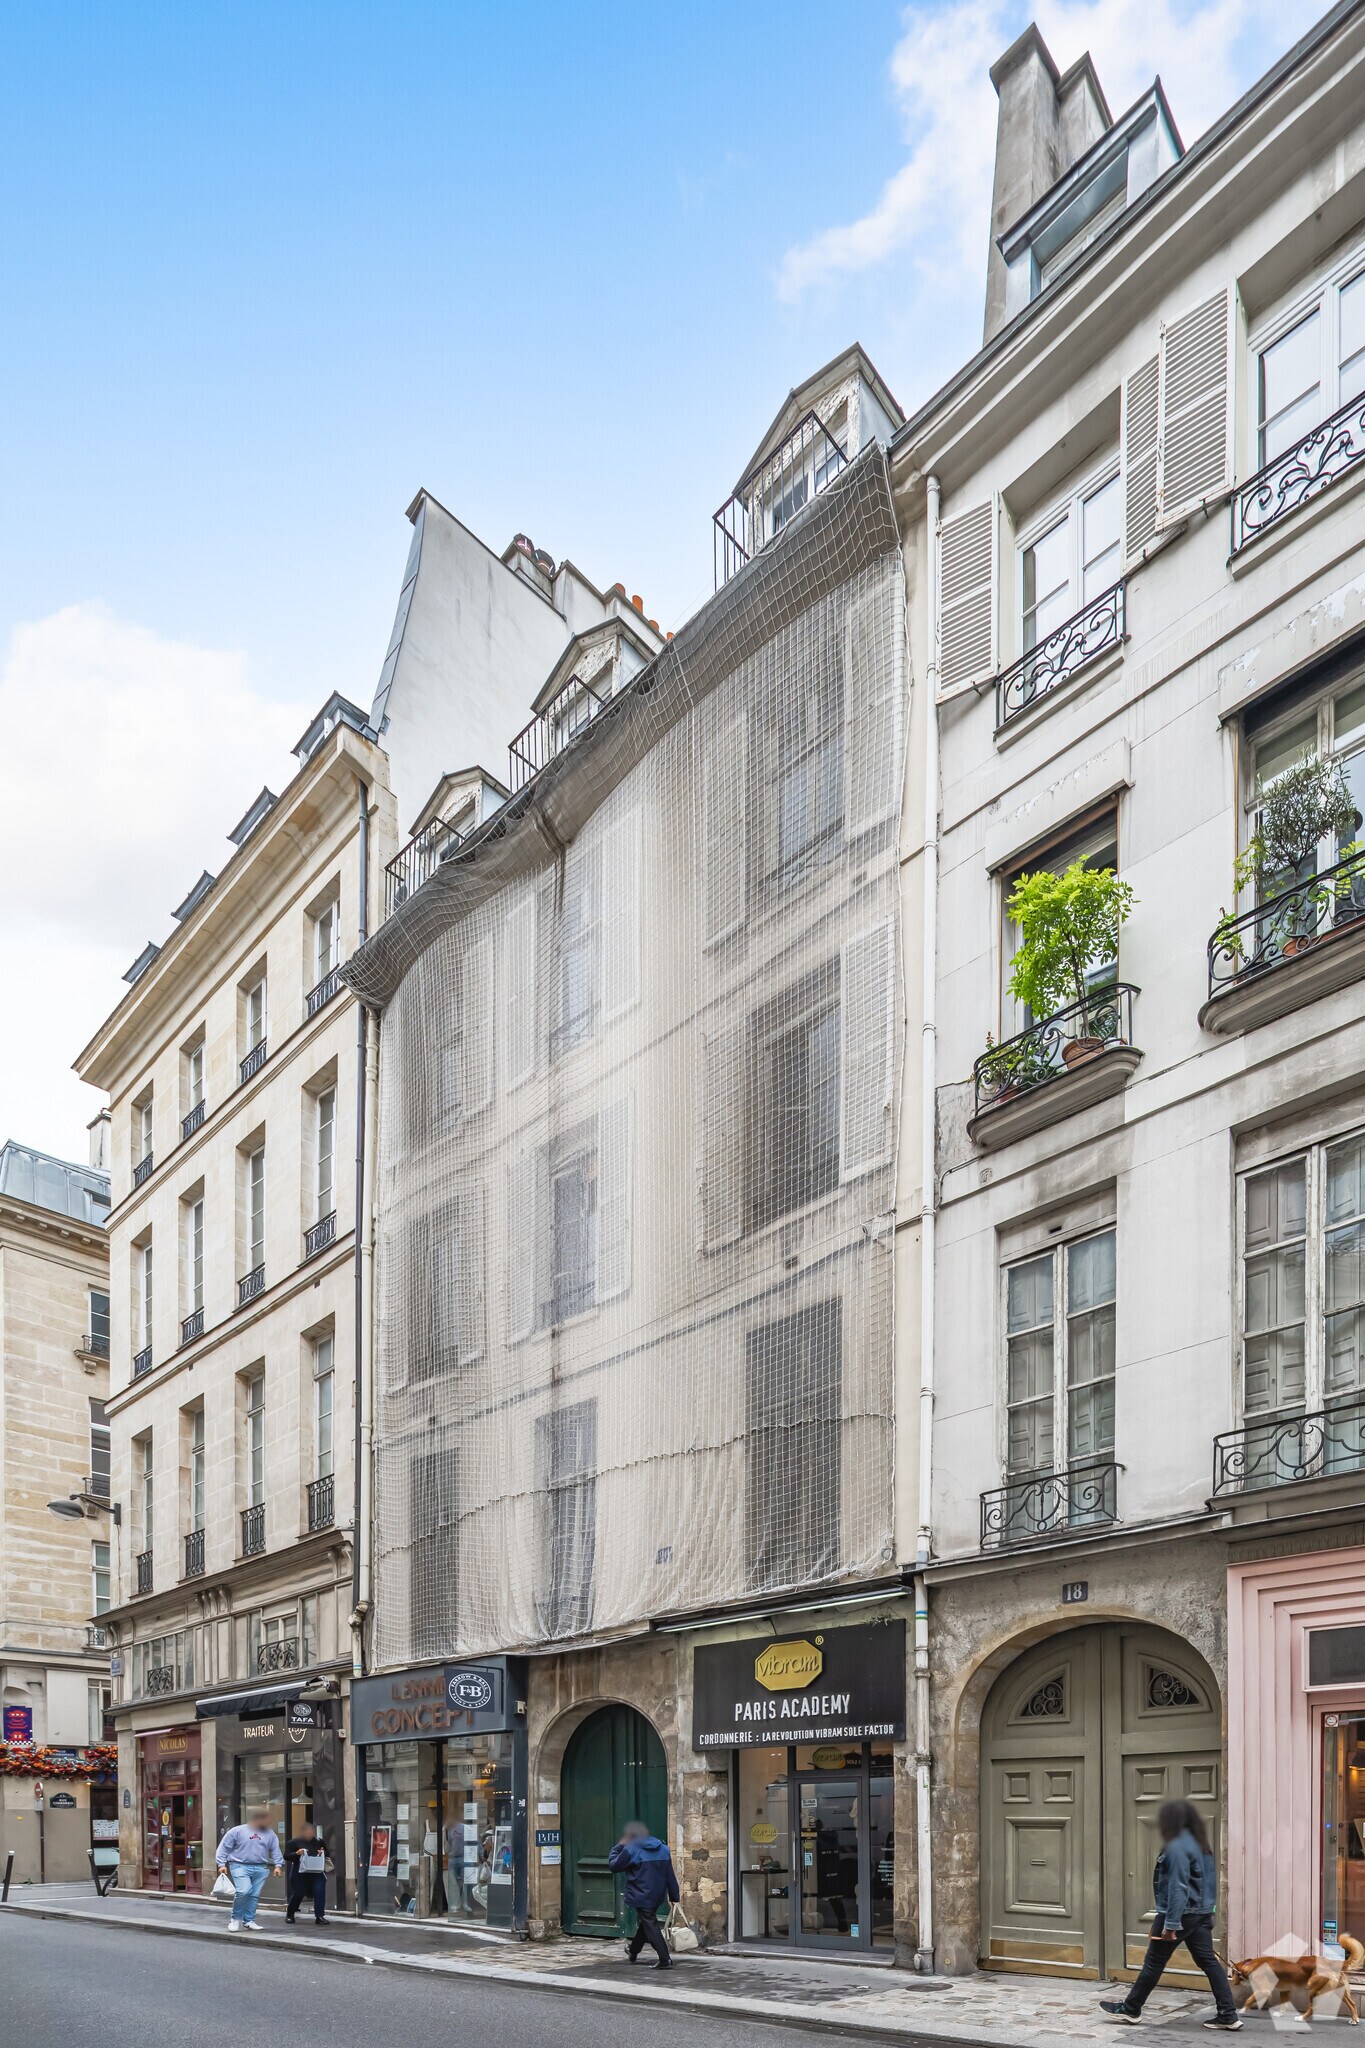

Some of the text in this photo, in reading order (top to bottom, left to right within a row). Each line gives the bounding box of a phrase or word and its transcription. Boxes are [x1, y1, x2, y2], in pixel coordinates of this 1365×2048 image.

[1066, 1584, 1083, 1601] 18
[759, 1654, 820, 1677] vibram
[458, 1684, 483, 1697] F&B
[735, 1694, 851, 1722] PARIS ACADEMY
[243, 1724, 274, 1739] TRAITEUR
[699, 1731, 753, 1745] CORDONNERIE
[762, 1732, 771, 1742] LA
[771, 1729, 814, 1741] REVOLUTION
[815, 1727, 843, 1739] VIBRAM
[843, 1726, 863, 1737] SOLE
[864, 1724, 894, 1736] FACTOR
[160, 1736, 186, 1751] NICOLAS
